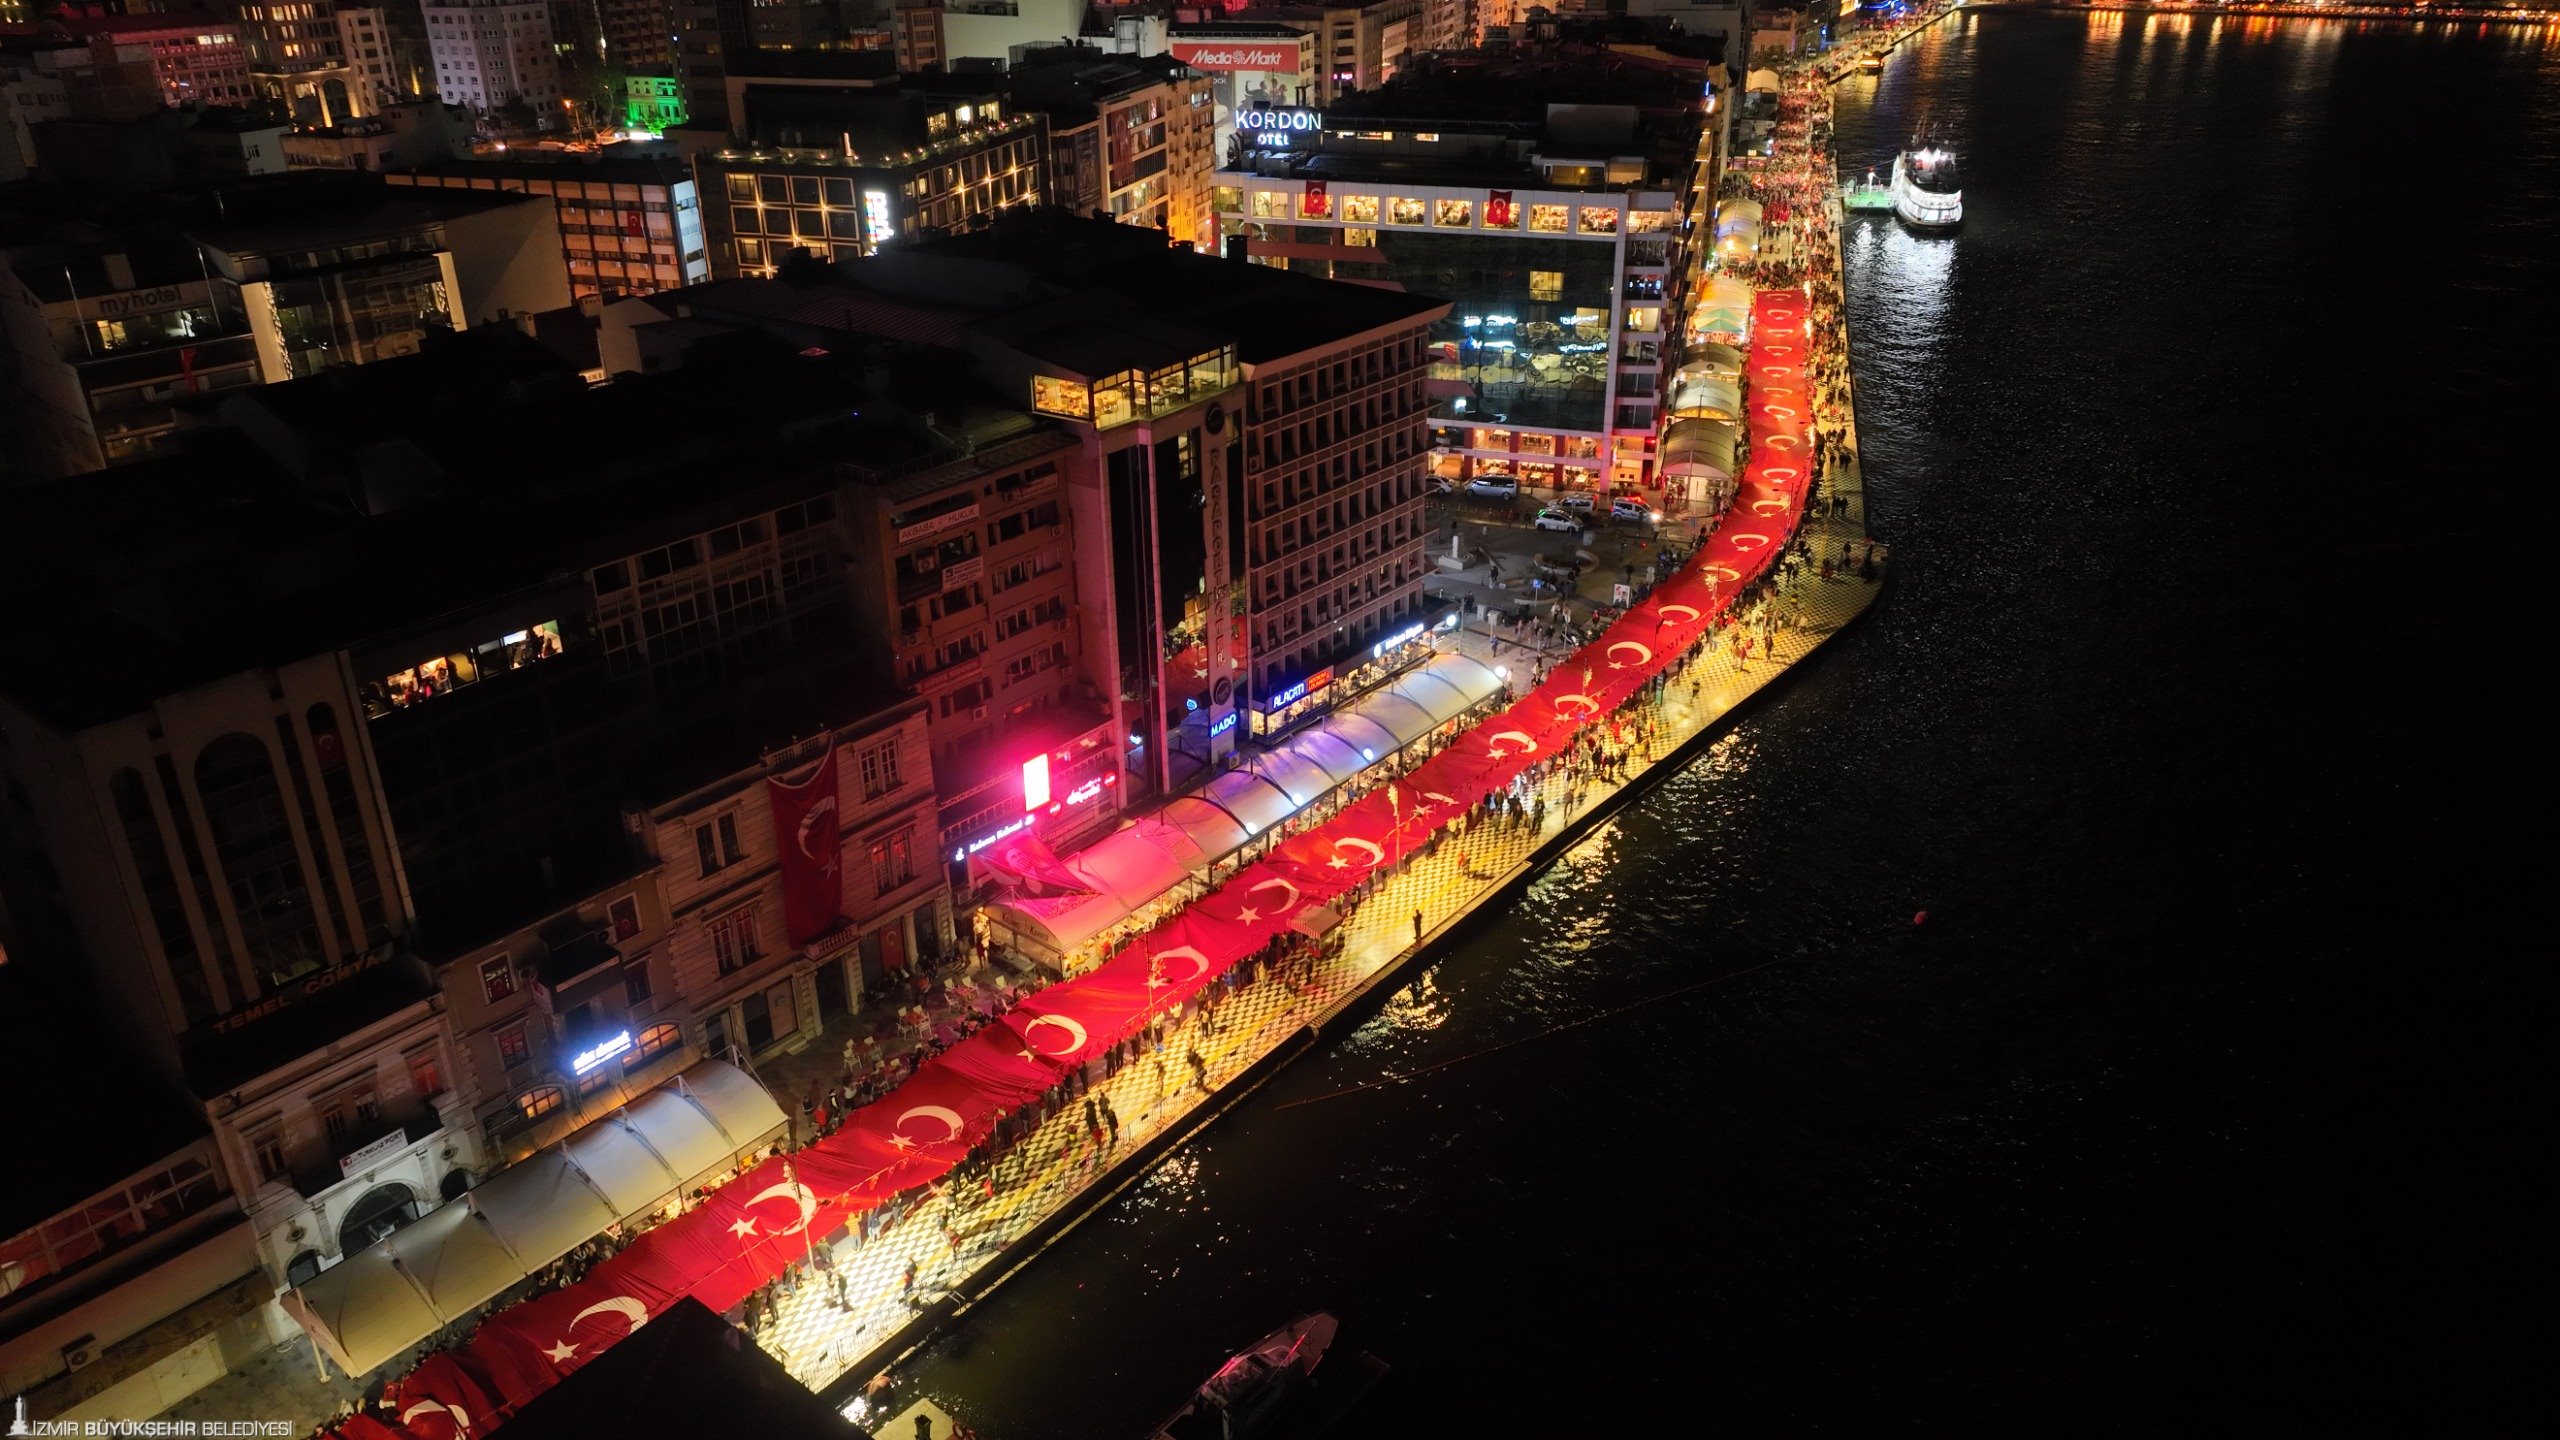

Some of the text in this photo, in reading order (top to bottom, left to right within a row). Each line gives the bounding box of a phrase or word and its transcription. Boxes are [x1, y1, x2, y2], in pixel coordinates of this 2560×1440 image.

[1190, 49, 1282, 65] Media Markt
[1235, 109, 1322, 130] KORDON
[1257, 132, 1290, 146] OTEL
[100, 285, 182, 312] myhotel
[901, 508, 976, 539] AKBABA HUKUK
[1211, 713, 1238, 738] MADO
[212, 995, 290, 1035] TEMEL
